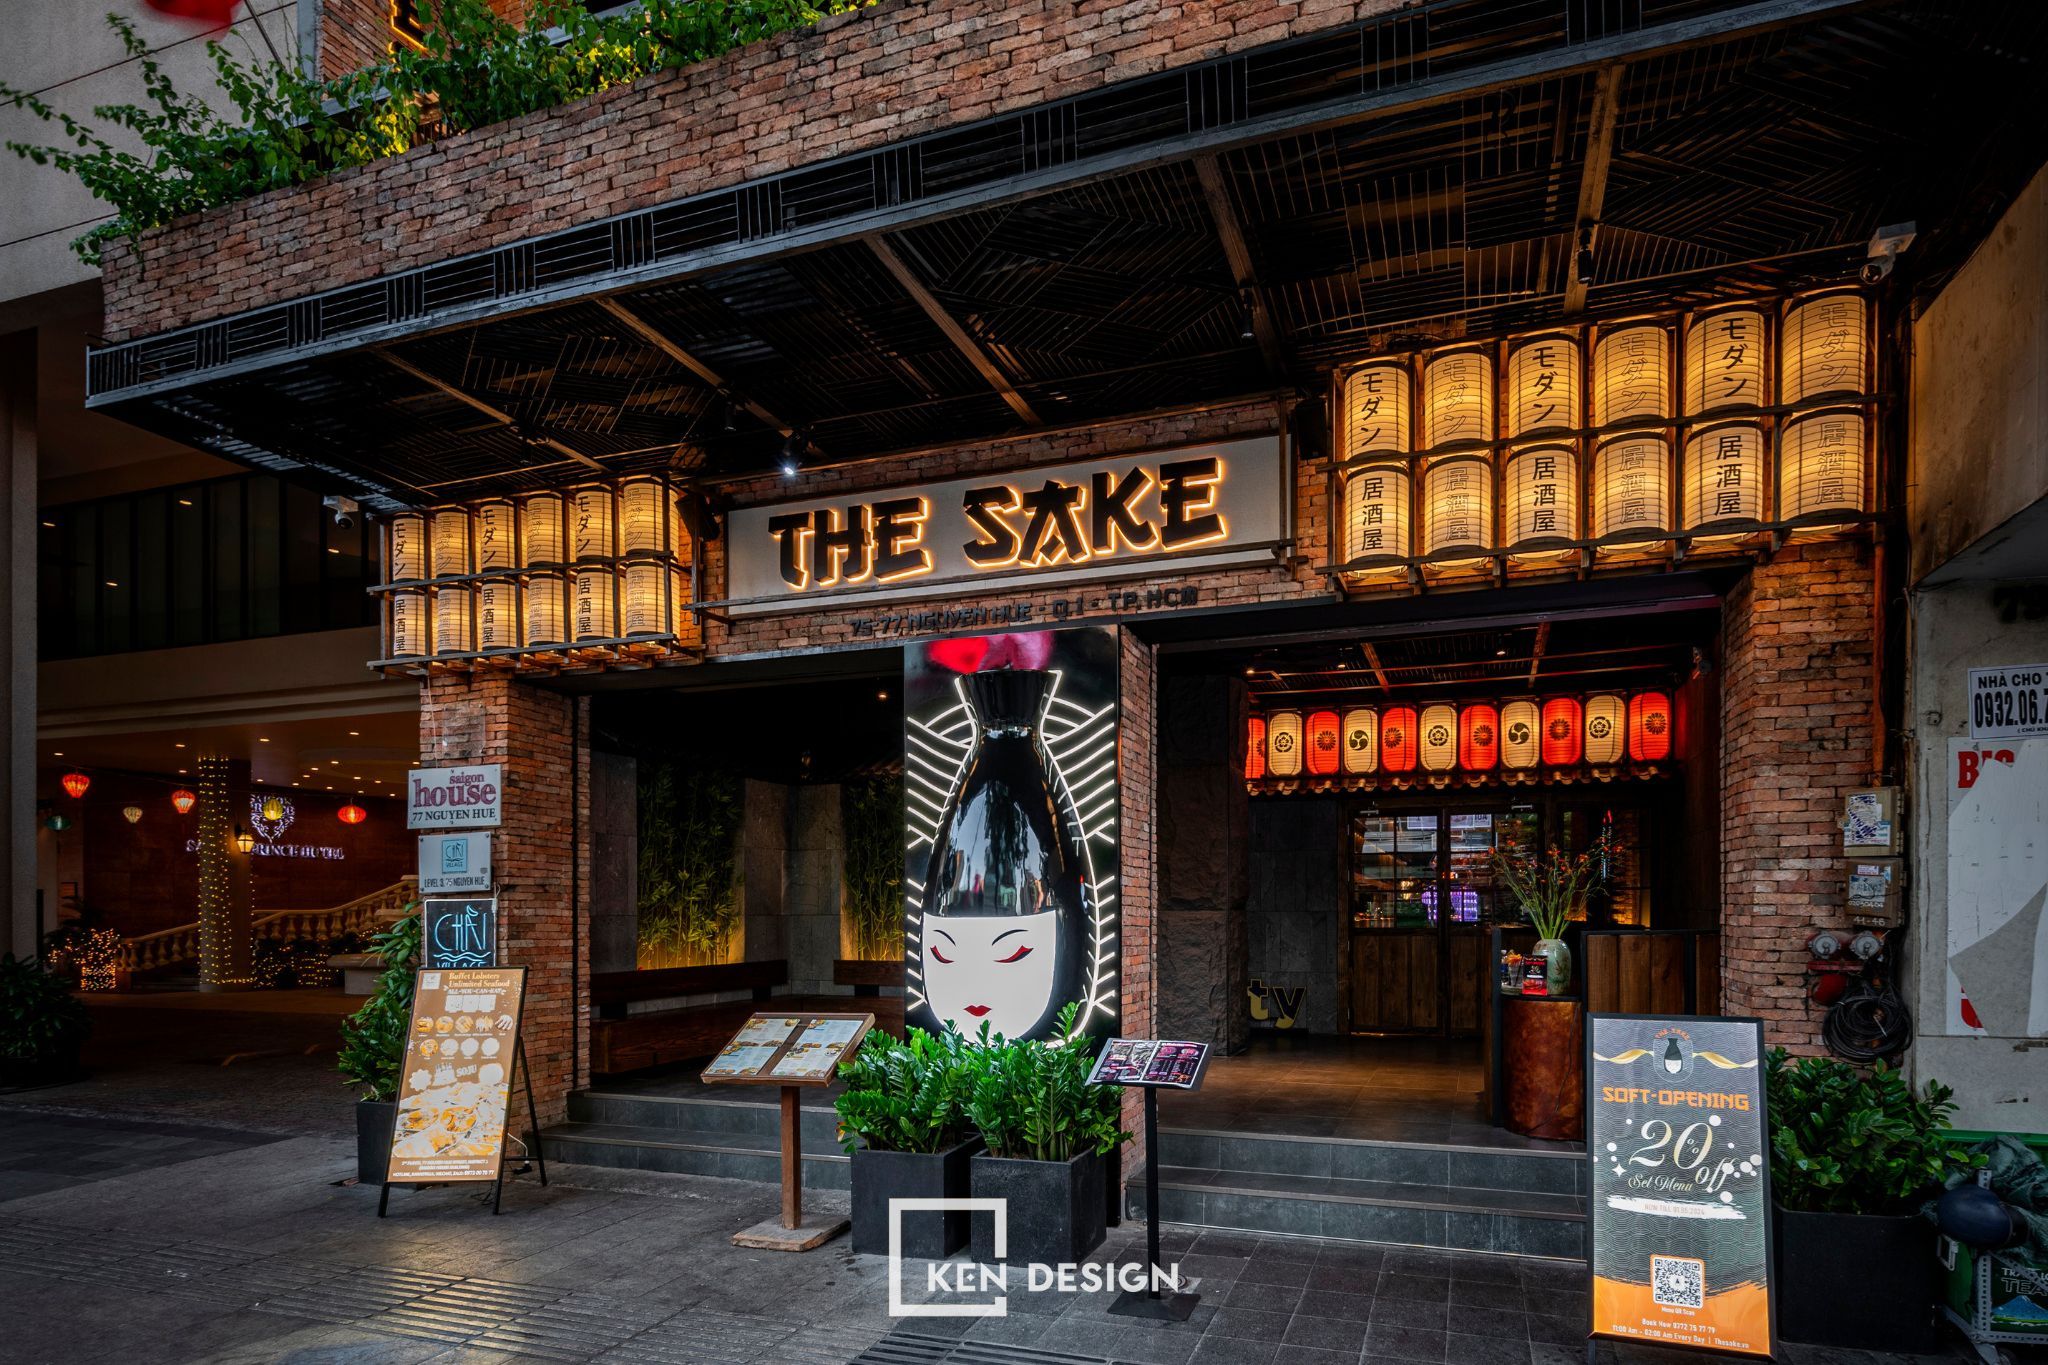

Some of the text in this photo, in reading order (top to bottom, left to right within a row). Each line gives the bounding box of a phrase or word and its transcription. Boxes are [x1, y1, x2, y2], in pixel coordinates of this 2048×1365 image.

[1532, 346, 1558, 424] モダン
[1721, 317, 1748, 398] モダン
[1361, 372, 1383, 447] モダン
[1531, 457, 1557, 533] 居酒屋
[1713, 435, 1743, 516] 居酒屋
[483, 508, 497, 564] モダン
[577, 495, 592, 553] モダン
[768, 456, 1228, 589] THE SAKE
[1361, 477, 1384, 552] 居酒屋
[394, 523, 406, 577] モダン
[483, 588, 495, 643] 居酒屋
[577, 577, 592, 634] 居酒屋
[850, 614, 902, 637] 75-77
[905, 608, 987, 632] NGUYEN
[988, 601, 1034, 624] HUE
[1978, 671, 2007, 689] NHÀ
[2012, 672, 2042, 686] CHO
[413, 778, 497, 809] house
[450, 772, 485, 786] saigon
[412, 807, 496, 822] 77 NGUYEN HUE
[456, 1064, 477, 1078] SOJU
[1628, 1174, 1693, 1192] Set Menu
[1628, 1326, 1638, 1334] Am
[1663, 1330, 1673, 1338] Am
[1674, 1332, 1692, 1342] Every
[1693, 1335, 1705, 1344] Day
[1642, 1318, 1657, 1326] Book
[1658, 1320, 1672, 1328] Now
